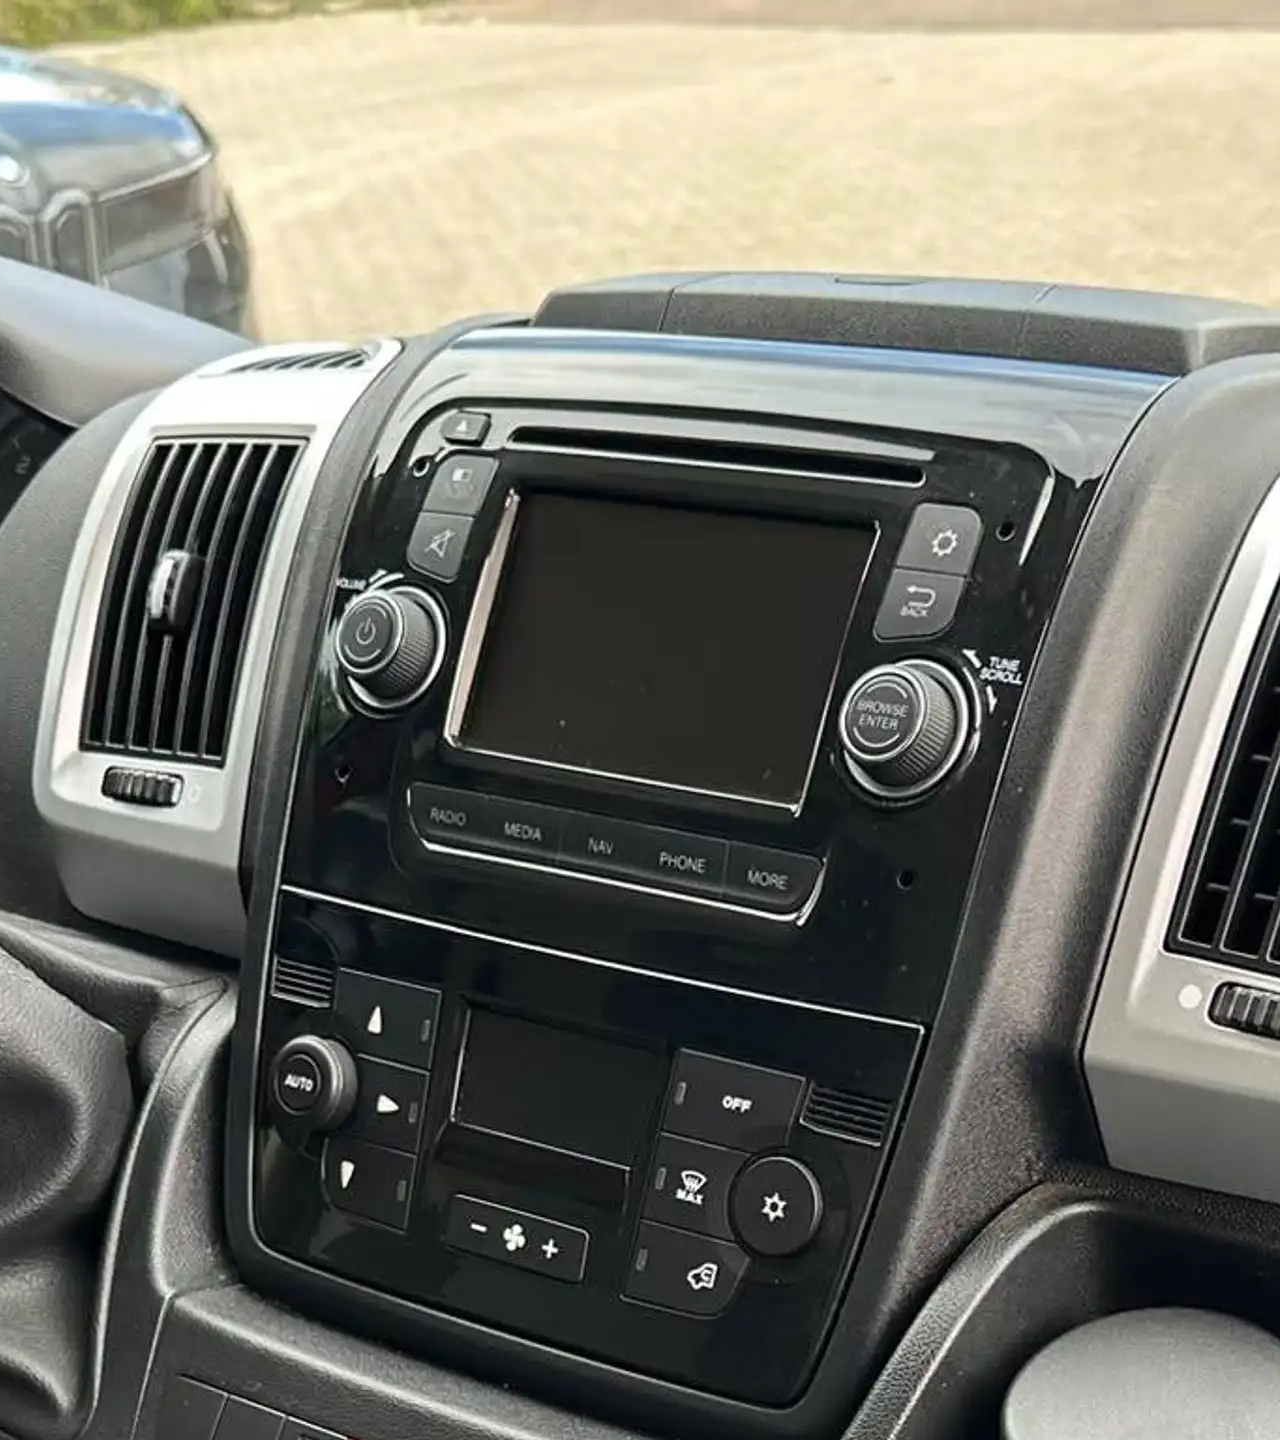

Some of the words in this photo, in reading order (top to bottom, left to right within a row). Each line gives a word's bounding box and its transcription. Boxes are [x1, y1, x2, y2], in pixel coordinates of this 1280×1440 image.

[900, 606, 928, 617] BACK
[989, 656, 1020, 672] TUNE
[979, 667, 1023, 685] SCROLL
[857, 699, 909, 718] BROWSE
[859, 714, 899, 730] ENTER
[430, 807, 467, 827] RADIO
[504, 821, 542, 842] MEDIA
[587, 837, 613, 855] NAV
[658, 851, 706, 874] PHONE
[747, 869, 789, 891] MORE
[284, 1074, 314, 1092] AUTO
[722, 1095, 752, 1113] OFF
[676, 1188, 703, 1205] MAX
